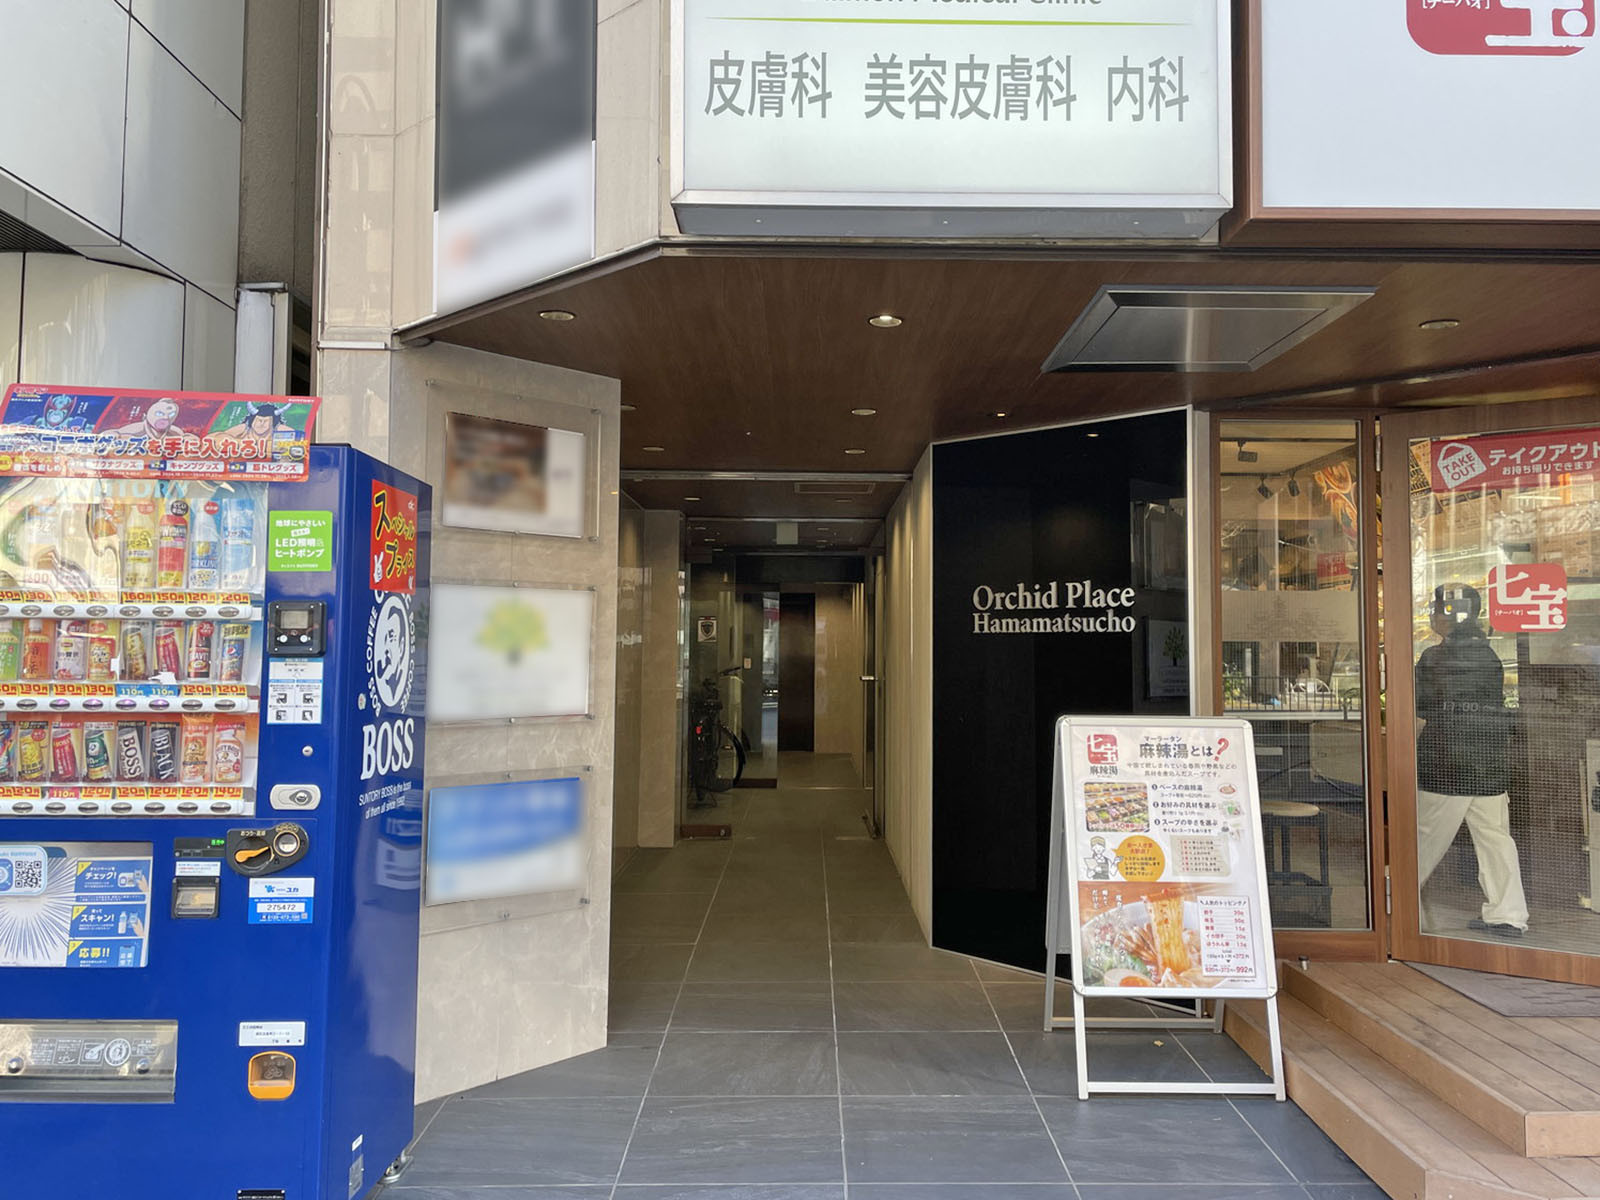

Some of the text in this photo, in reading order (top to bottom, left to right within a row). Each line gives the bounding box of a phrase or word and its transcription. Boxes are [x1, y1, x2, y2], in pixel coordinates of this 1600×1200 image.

[704, 50, 1189, 122] 皮膚科 美容皮膚科 内科
[1443, 452, 1476, 475] TAKE
[1488, 441, 1600, 466] テイクアウト
[1451, 463, 1477, 481] OUT
[1502, 461, 1594, 475] お持ち帰りできます
[275, 519, 326, 528] 地球にやさしい
[275, 548, 325, 558] ヒートポンプ
[385, 539, 415, 579] プライス
[122, 592, 152, 602] 160円
[156, 593, 184, 602] 150円
[972, 580, 1136, 611] Orchid Place
[1488, 564, 1568, 629] 七宝
[972, 609, 1136, 634] Hamamatsucho
[366, 606, 378, 674] COFFEE
[20, 684, 48, 694] 130円
[54, 684, 82, 695] 130円
[86, 685, 113, 695] 130円
[182, 686, 212, 694] 120円
[217, 686, 246, 694] 120円
[123, 736, 142, 778] BOSS
[152, 732, 175, 780] BLACK
[360, 718, 414, 780] BOSS
[1139, 738, 1230, 760] 麻辣湯とは?
[82, 787, 110, 796] 120円
[117, 787, 146, 796] 120円
[149, 787, 178, 796] 120円
[181, 787, 209, 796] 120円
[214, 787, 242, 796] 140円
[359, 790, 380, 807] SUNTORY
[381, 785, 393, 799] BOSS
[85, 871, 117, 880] チェック!
[80, 913, 115, 922] スキャン!
[79, 947, 111, 959] 応募!!
